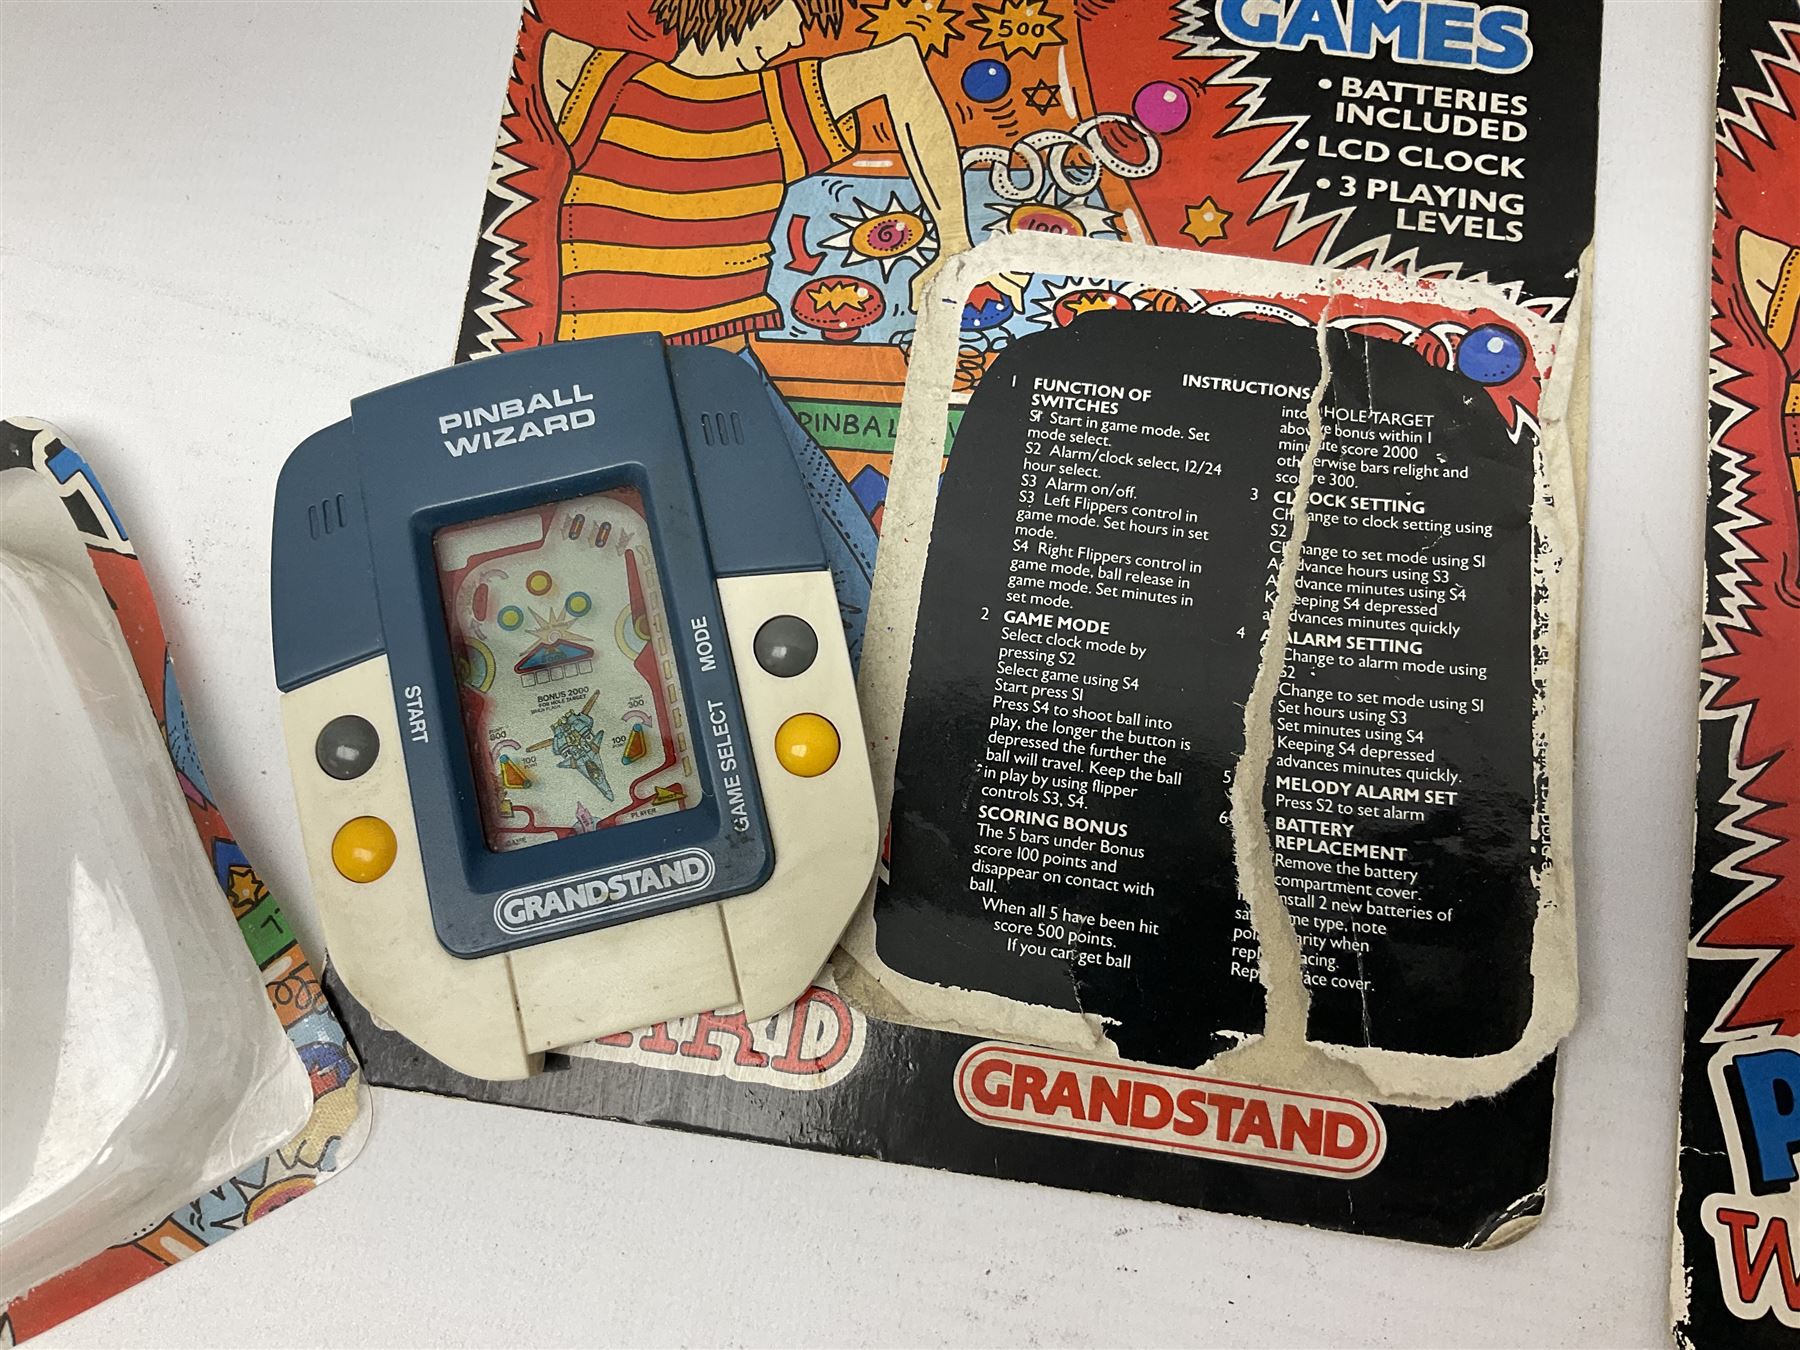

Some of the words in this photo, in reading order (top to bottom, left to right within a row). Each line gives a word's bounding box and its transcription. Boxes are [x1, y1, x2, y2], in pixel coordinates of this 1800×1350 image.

[998, 20, 1045, 37] 500
[1217, 0, 1532, 73] GAMES
[1342, 77, 1528, 115] BATTERIES
[1336, 102, 1527, 142] INCLUDED
[1318, 136, 1390, 162] LCD
[1398, 145, 1525, 178] CLOCK
[1339, 175, 1356, 197] 3
[1367, 178, 1524, 216] PLAYING
[1396, 208, 1523, 243] LEVELS
[1034, 377, 1125, 400] FUNCTION
[1128, 388, 1152, 402] OF
[1182, 374, 1311, 400] INSTRUCTIONS
[439, 384, 593, 434] PINBALL
[1031, 393, 1119, 415] SWITCHES
[799, 411, 896, 438] PINBAL
[1050, 411, 1083, 428] Start
[1100, 421, 1138, 434] game
[1141, 425, 1184, 439] mode.
[1372, 411, 1434, 427] TARGET
[444, 408, 596, 457] WIZARD
[1027, 428, 1066, 442] mode
[1069, 431, 1112, 447] select.
[1378, 429, 1423, 444] within
[1023, 457, 1056, 473] hour
[1049, 444, 1134, 466] Alarm/clock
[1136, 456, 1180, 473] select,
[1185, 460, 1222, 476] 12/24
[1382, 445, 1418, 460] 2000
[1329, 472, 1358, 489] 300.
[1360, 460, 1390, 474] bars
[1393, 463, 1440, 481] relight
[1442, 466, 1469, 479] and
[1045, 476, 1088, 494] Alarm
[1091, 483, 1137, 500] on/off.
[1250, 488, 1259, 500] 3
[1350, 496, 1425, 514] SETTING
[1044, 492, 1071, 508] Left
[1074, 496, 1128, 516] Flippers
[1132, 506, 1182, 521] control
[1016, 509, 1054, 523] game
[1129, 518, 1168, 536] hours
[1188, 530, 1209, 541] set
[1362, 514, 1399, 530] clock
[1402, 519, 1452, 536] setting
[1038, 542, 1074, 560] Right
[1077, 546, 1132, 566] Flippers
[1135, 557, 1186, 572] control
[1361, 551, 1383, 562] set
[1098, 565, 1122, 581] ball
[1125, 570, 1174, 587] release
[1347, 563, 1388, 579] hours
[1121, 588, 1178, 605] minutes
[1347, 582, 1405, 597] minutes
[1364, 598, 1438, 617] depressed
[980, 607, 990, 621] 2
[1004, 610, 1054, 628] GAME
[1057, 616, 1110, 635] MODE
[1410, 621, 1461, 639] quickly
[691, 616, 716, 672] MODE
[1046, 632, 1082, 649] clock
[1236, 626, 1246, 640] 4
[1346, 636, 1423, 655] SETTING
[998, 648, 1056, 667] pressing
[1283, 648, 1335, 668] Change
[1358, 654, 1398, 671] alarm
[537, 690, 567, 703] BONUS
[568, 686, 589, 697] 2000
[994, 678, 1028, 694] Start
[1031, 686, 1068, 700] press
[1083, 674, 1120, 692] using
[1278, 682, 1334, 704] Change
[405, 686, 428, 743] START
[993, 695, 1030, 712] Press
[1032, 700, 1050, 714] S4
[1072, 706, 1113, 723] shoot
[1116, 710, 1141, 726] ball
[1144, 715, 1173, 730] into
[1390, 710, 1407, 725] S3
[612, 735, 627, 744] 100
[708, 700, 737, 772] SELECT
[990, 713, 1021, 732] play,
[1052, 720, 1098, 740] longer
[1128, 730, 1176, 749] button
[988, 730, 1059, 752] depressed
[1090, 742, 1140, 762] further
[1278, 735, 1335, 758] Keeping
[1042, 757, 1084, 773] travel.
[1089, 760, 1126, 782] Keep
[1130, 766, 1153, 782] the
[1276, 754, 1339, 772] advances
[1406, 767, 1462, 786] quickly.
[981, 786, 1039, 803] controls
[999, 768, 1029, 787] play
[1052, 776, 1088, 795] using
[1092, 779, 1138, 799] flipper
[1223, 770, 1232, 784] 5
[1276, 775, 1352, 796] MELODY
[1355, 784, 1420, 803] ALARM
[1424, 790, 1458, 806] SET
[725, 774, 749, 832] GAME
[978, 805, 1059, 828] SCORING
[1063, 816, 1128, 838] BONUS
[1219, 811, 1229, 824] 6
[1276, 816, 1354, 838] BATTERY
[976, 822, 1004, 839] The
[1020, 828, 1050, 845] bars
[1054, 836, 1097, 851] under
[1100, 839, 1145, 858] Bonus
[1275, 834, 1408, 862] REPLACEMENT
[974, 844, 1013, 859] score
[1017, 846, 1040, 862] 100
[1042, 853, 1087, 869] points
[1090, 859, 1117, 873] and
[1274, 853, 1332, 873] Remove
[1336, 861, 1360, 876] the
[1364, 863, 1418, 886] battery
[503, 856, 706, 924] GRANDSTAND
[972, 858, 1040, 881] disappear
[1065, 875, 1119, 892] contact
[1123, 882, 1154, 897] with
[1274, 875, 1372, 896] compartment
[1376, 887, 1422, 901] cover.
[982, 896, 1026, 916] When
[1030, 904, 1046, 919] all
[1062, 908, 1096, 926] have
[1100, 913, 1135, 932] been
[1139, 918, 1159, 935] hit
[1332, 901, 1363, 913] new
[1366, 900, 1433, 920] batteries
[993, 921, 1033, 936] score
[1036, 923, 1065, 940] 500
[1068, 931, 1116, 948] points.
[1314, 917, 1348, 933] type,
[1352, 922, 1387, 935] note
[1330, 936, 1369, 952] when
[1331, 976, 1375, 992] cover.
[971, 1059, 1368, 1160] GRANDSTAND
